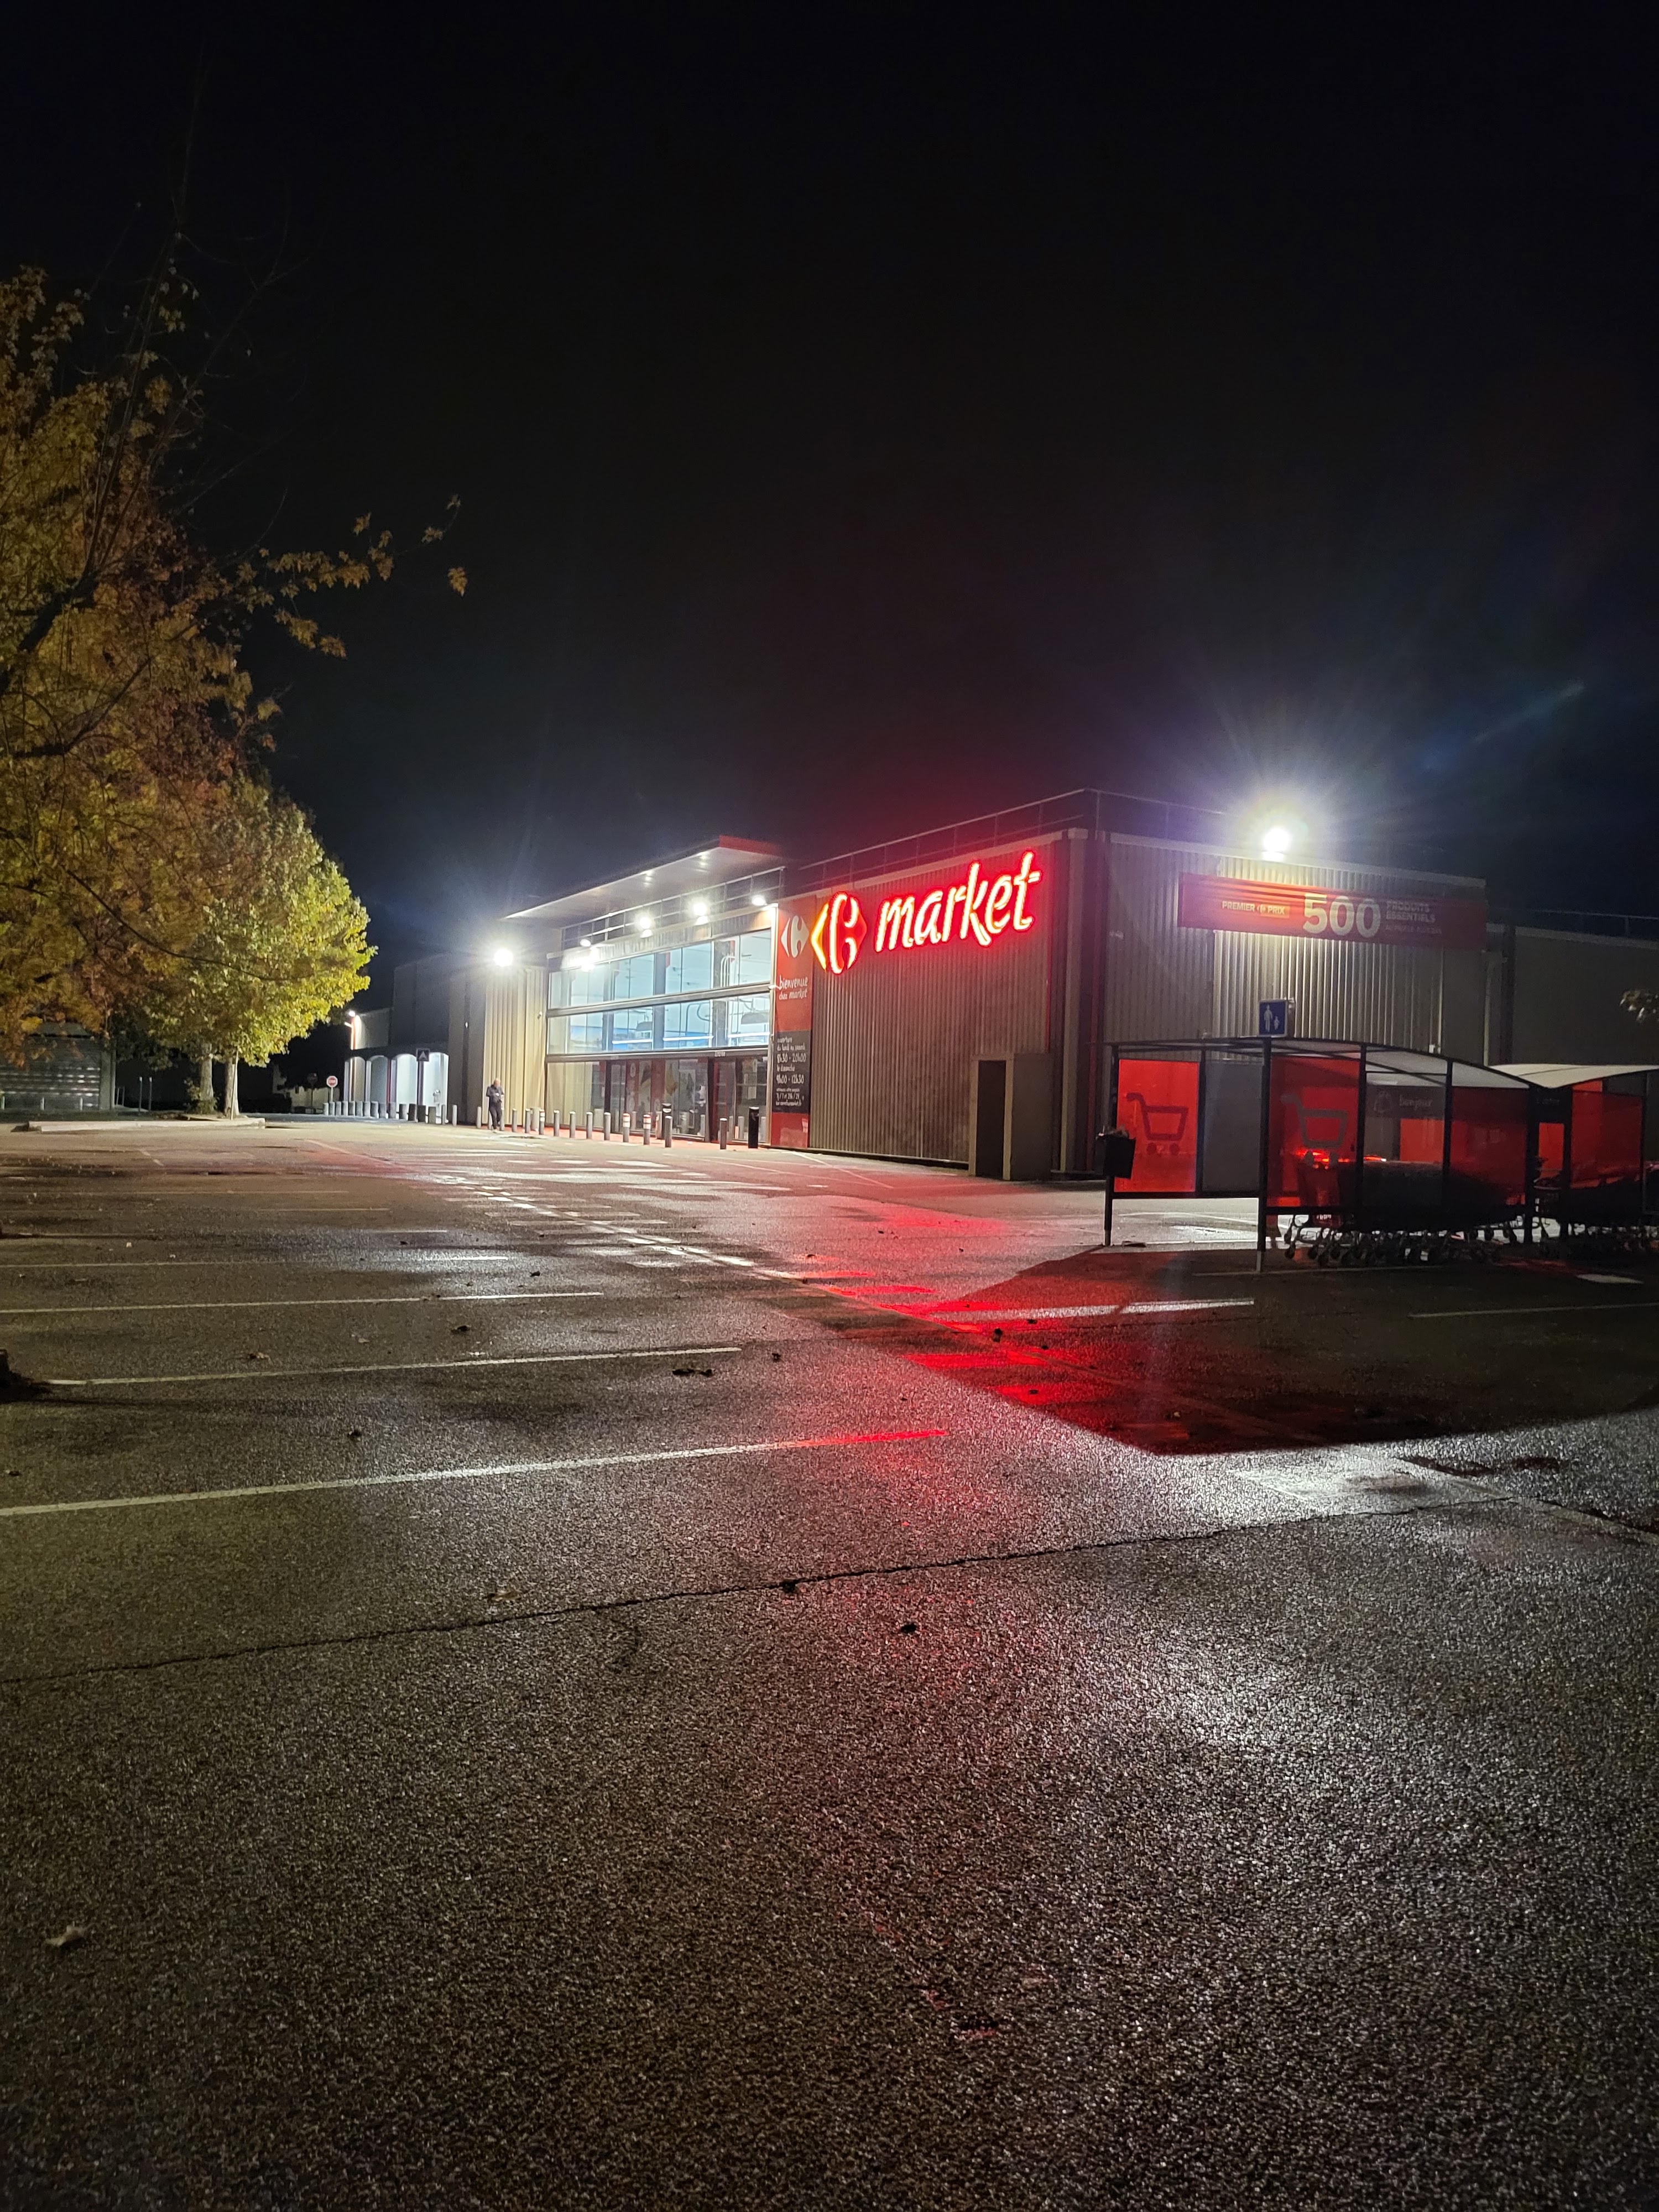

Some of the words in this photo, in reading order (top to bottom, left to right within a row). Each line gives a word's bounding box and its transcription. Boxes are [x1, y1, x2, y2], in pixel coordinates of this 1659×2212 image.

[875, 851, 1041, 952] market
[1222, 901, 1255, 912] PREMIER
[1267, 905, 1285, 915] PRIX
[1303, 893, 1381, 938] 500
[779, 974, 808, 990] bienvenue
[776, 1073, 787, 1084] 9h00
[791, 1073, 805, 1084] 12h30
